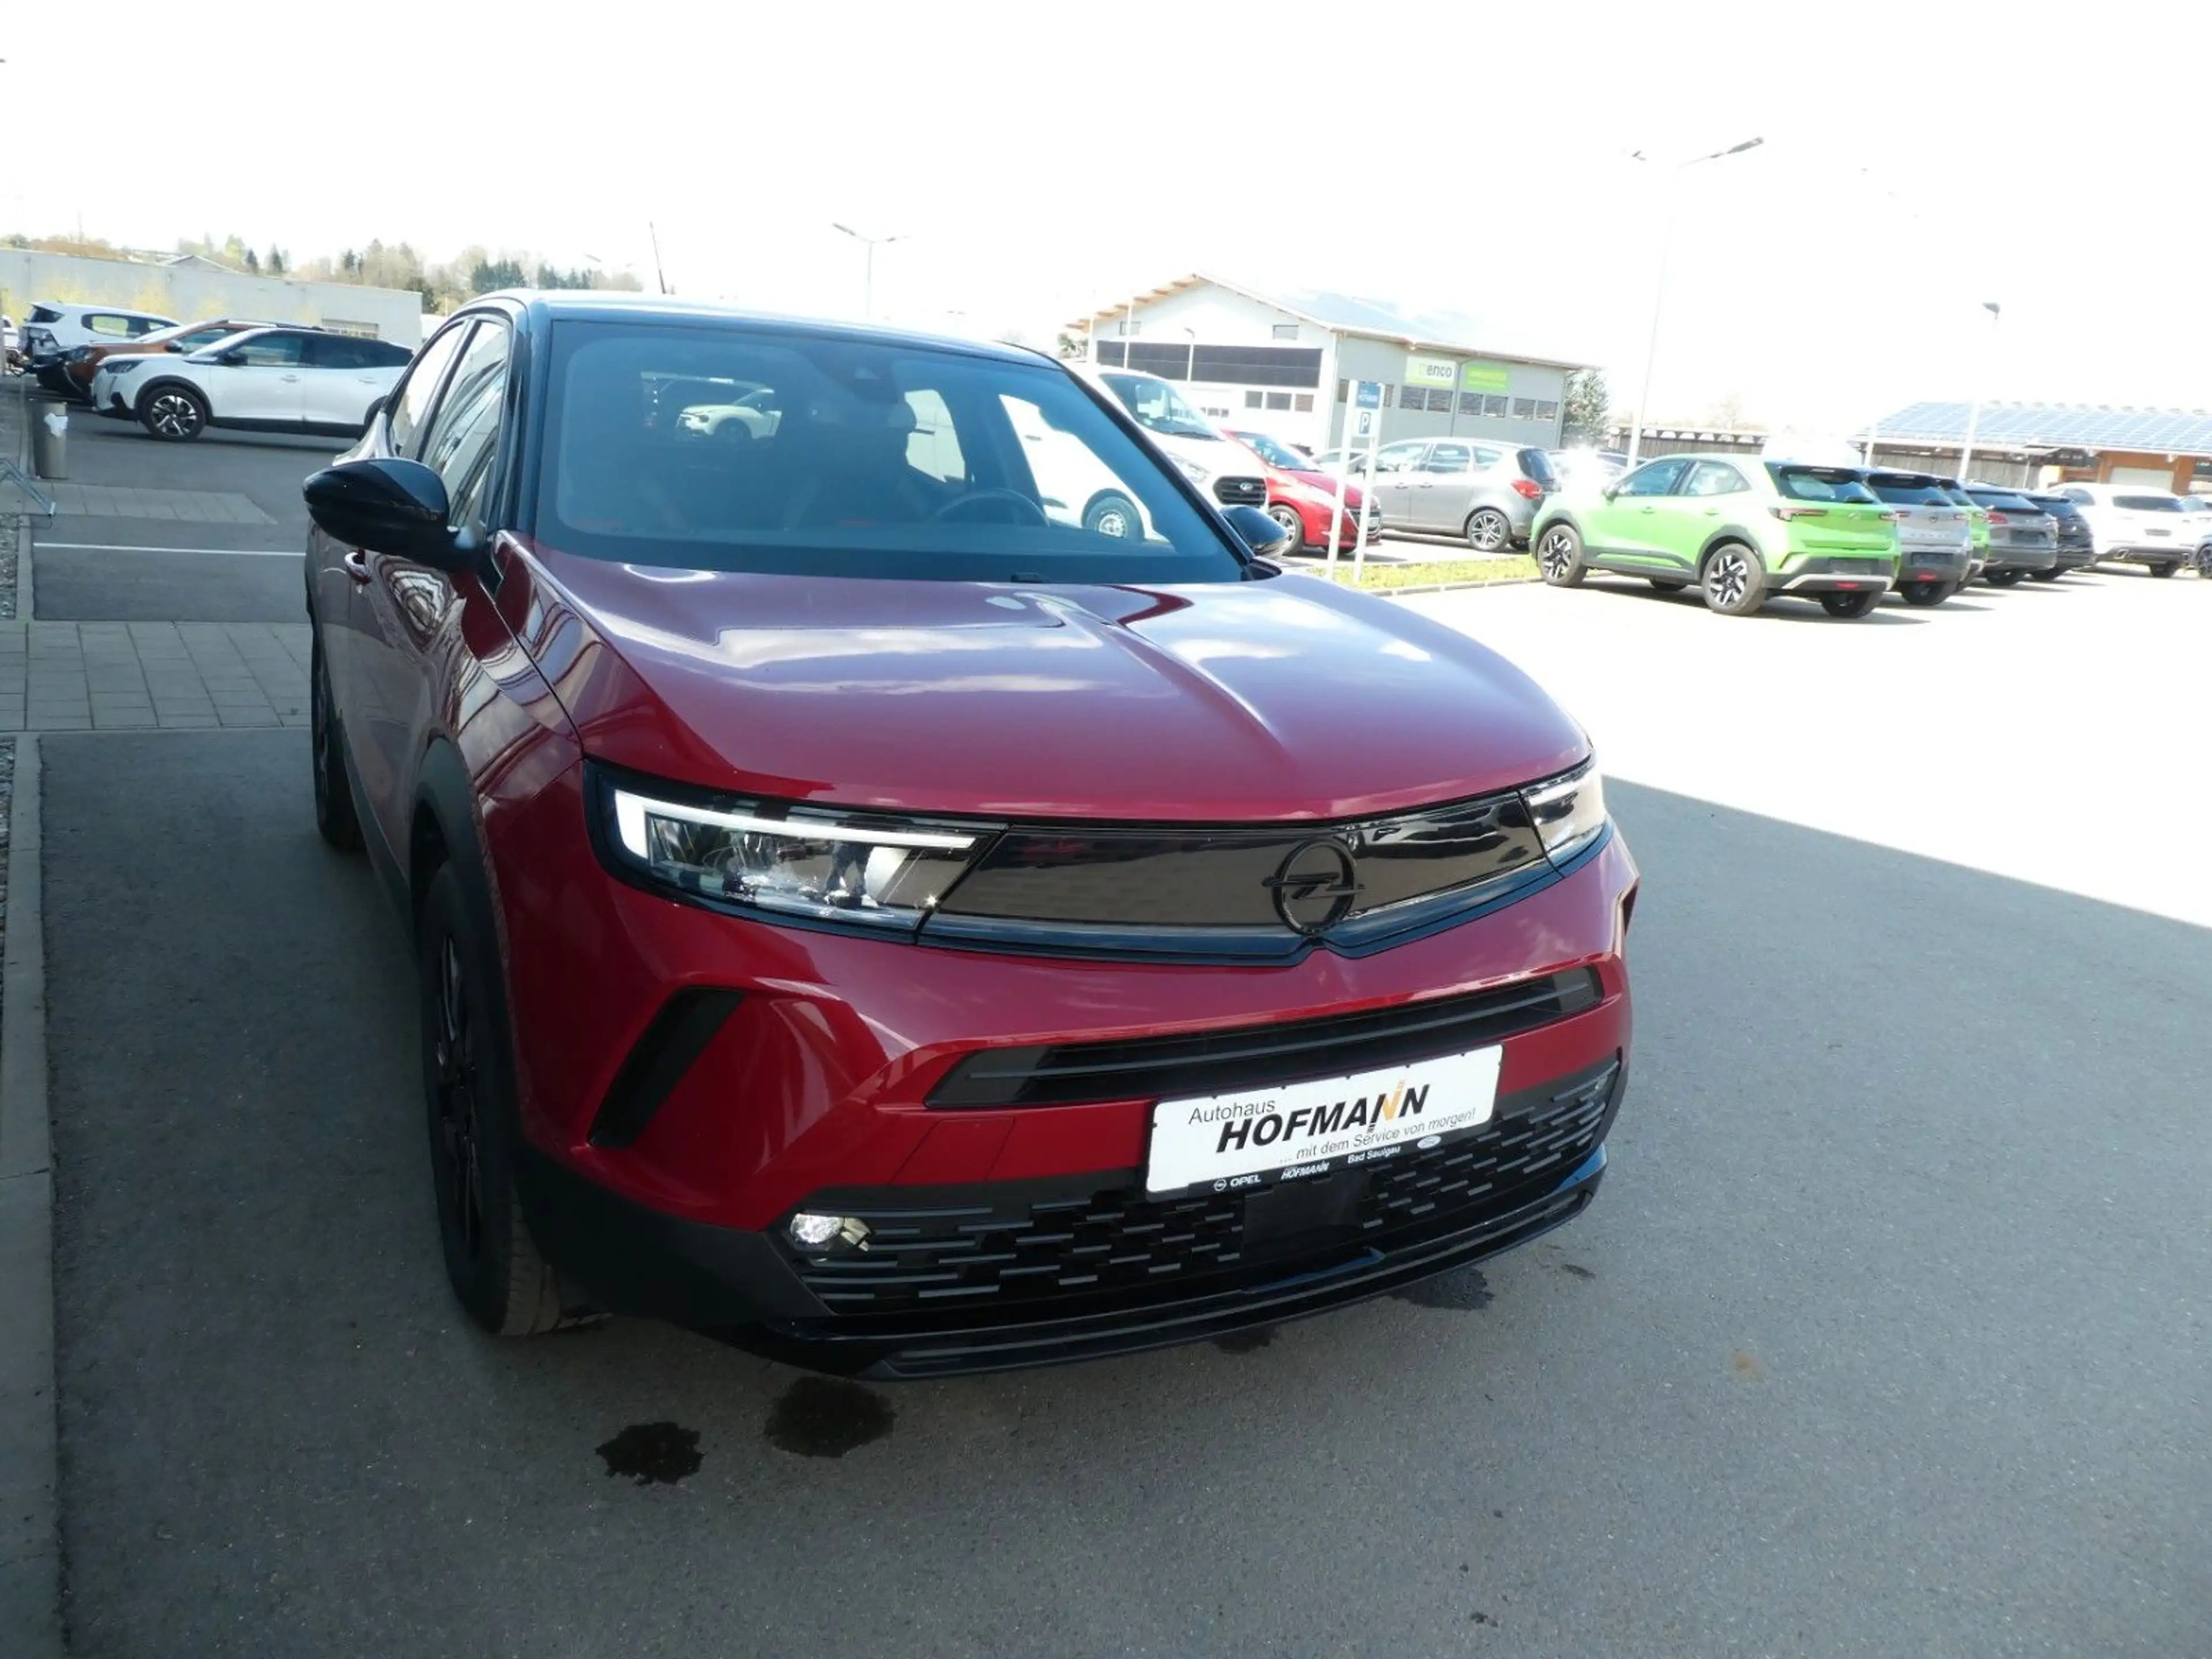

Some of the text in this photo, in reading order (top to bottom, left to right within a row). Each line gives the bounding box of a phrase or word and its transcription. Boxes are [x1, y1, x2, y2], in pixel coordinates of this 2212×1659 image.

[1427, 364, 1452, 377] enco
[1188, 1100, 1275, 1124] Autohaus
[1216, 1082, 1430, 1153] HOFMANN
[1296, 1144, 1317, 1159] mit
[1320, 1140, 1349, 1154] dem
[1354, 1127, 1400, 1147] Service
[1404, 1123, 1425, 1135] von
[1428, 1107, 1476, 1132] morgen!
[1347, 1146, 1401, 1164] Bad Saulgau
[1281, 1161, 1330, 1180] HOFMANN
[1230, 1175, 1262, 1187] OPEL
